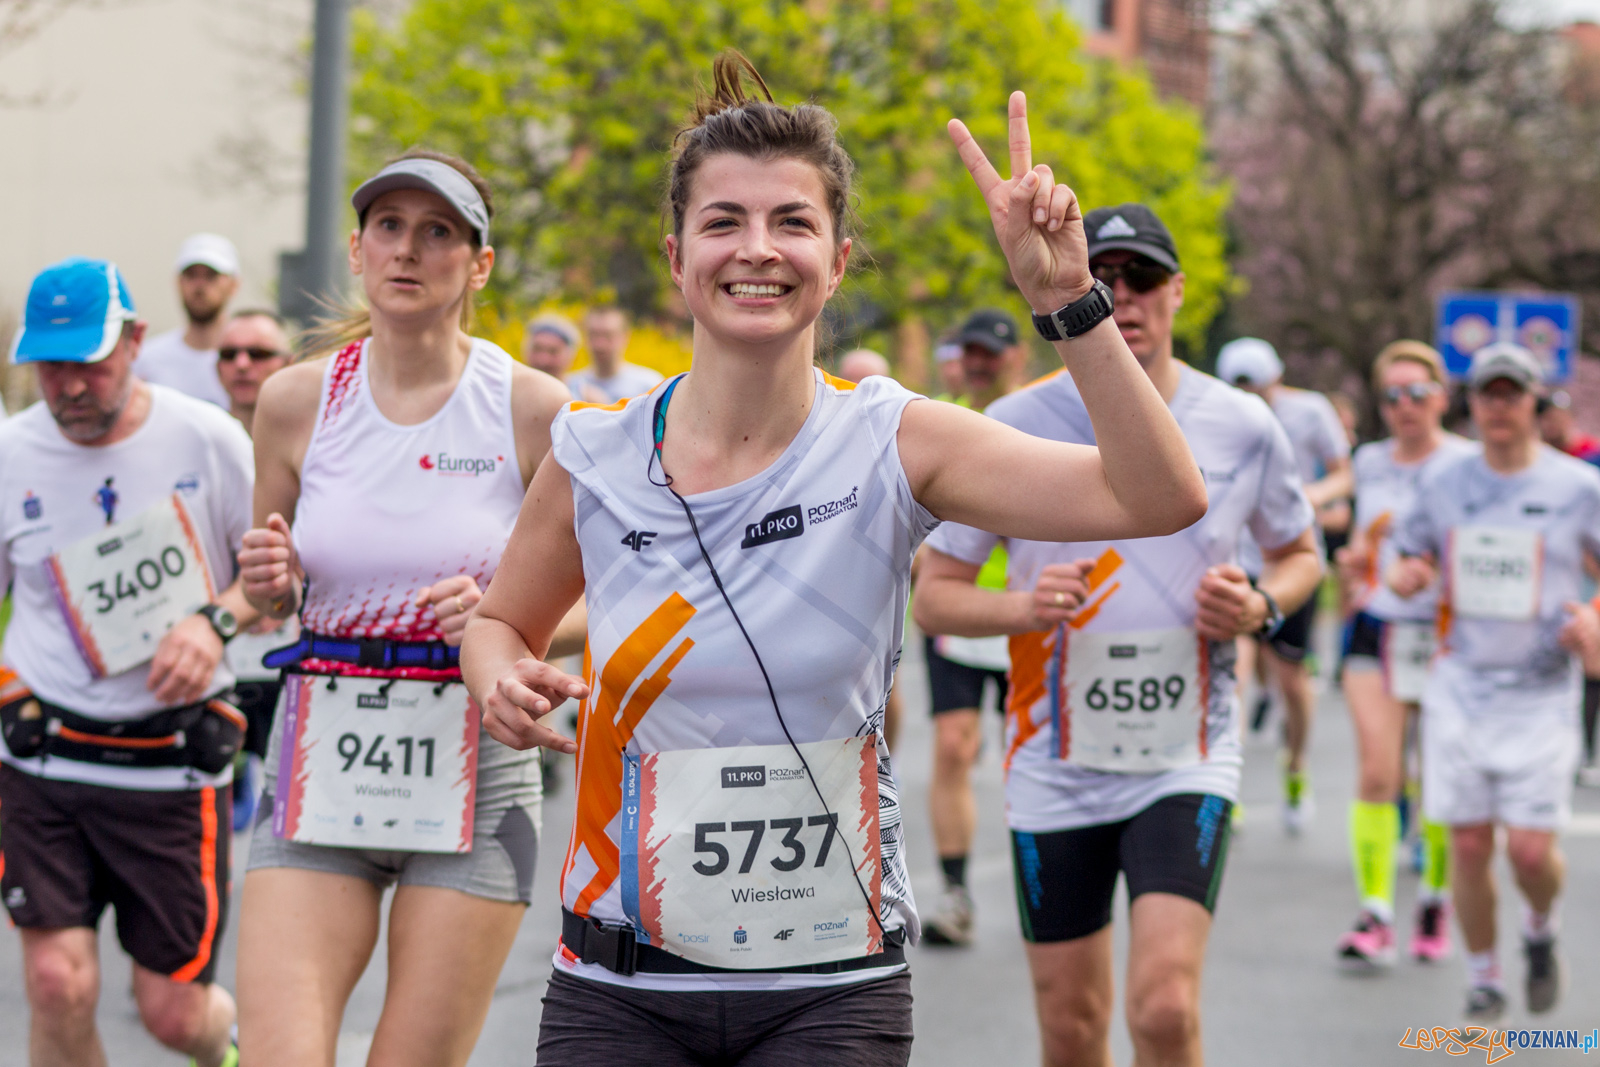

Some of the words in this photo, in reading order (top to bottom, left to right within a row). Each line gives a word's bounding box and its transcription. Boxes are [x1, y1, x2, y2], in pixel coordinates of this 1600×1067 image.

[437, 453, 495, 477] Europa
[767, 515, 798, 534] PKO
[620, 530, 658, 552] 4F
[87, 546, 185, 614] 3400
[1085, 674, 1186, 713] 6589
[337, 732, 436, 777] 9411
[727, 772, 739, 782] 11.
[740, 771, 763, 781] PKO
[355, 784, 412, 799] Wioletta
[627, 806, 637, 815] C
[691, 812, 839, 877] 5737
[731, 886, 815, 903] Wiesława
[773, 929, 795, 941] 4F
